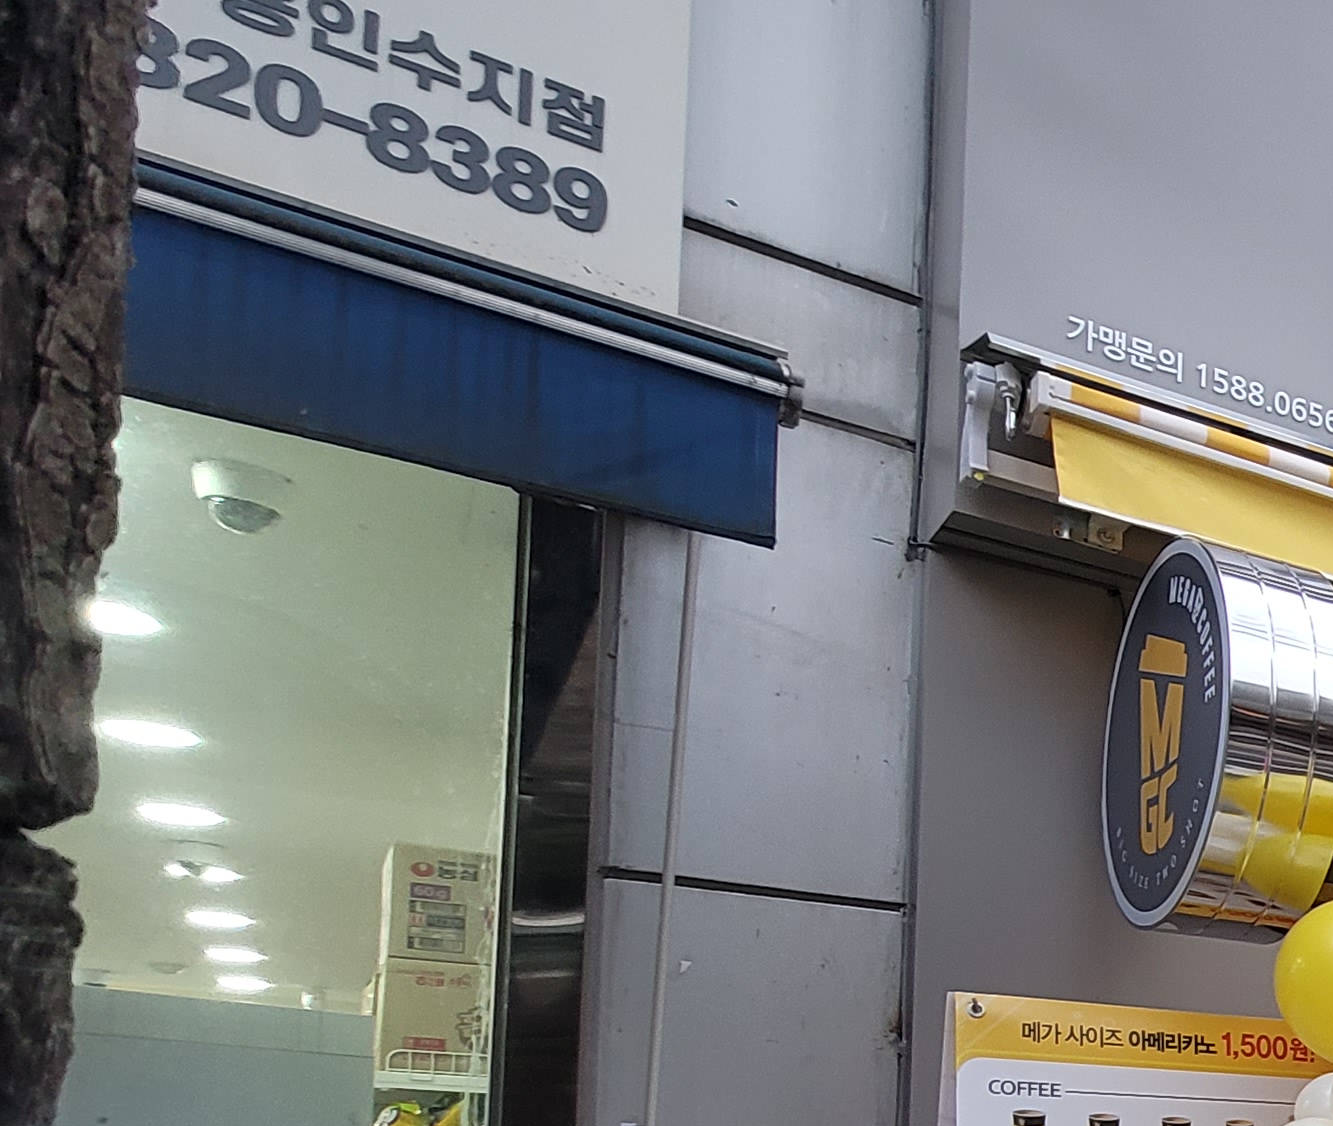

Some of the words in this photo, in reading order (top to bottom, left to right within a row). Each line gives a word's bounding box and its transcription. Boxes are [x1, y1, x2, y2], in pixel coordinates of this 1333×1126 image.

[1067, 315, 1184, 383] 가맹문의
[1021, 1020, 1062, 1046] 메가
[1064, 1024, 1124, 1048] 사이즈
[1128, 1030, 1218, 1057] 아메리카노
[988, 1079, 1062, 1098] COFFEE
